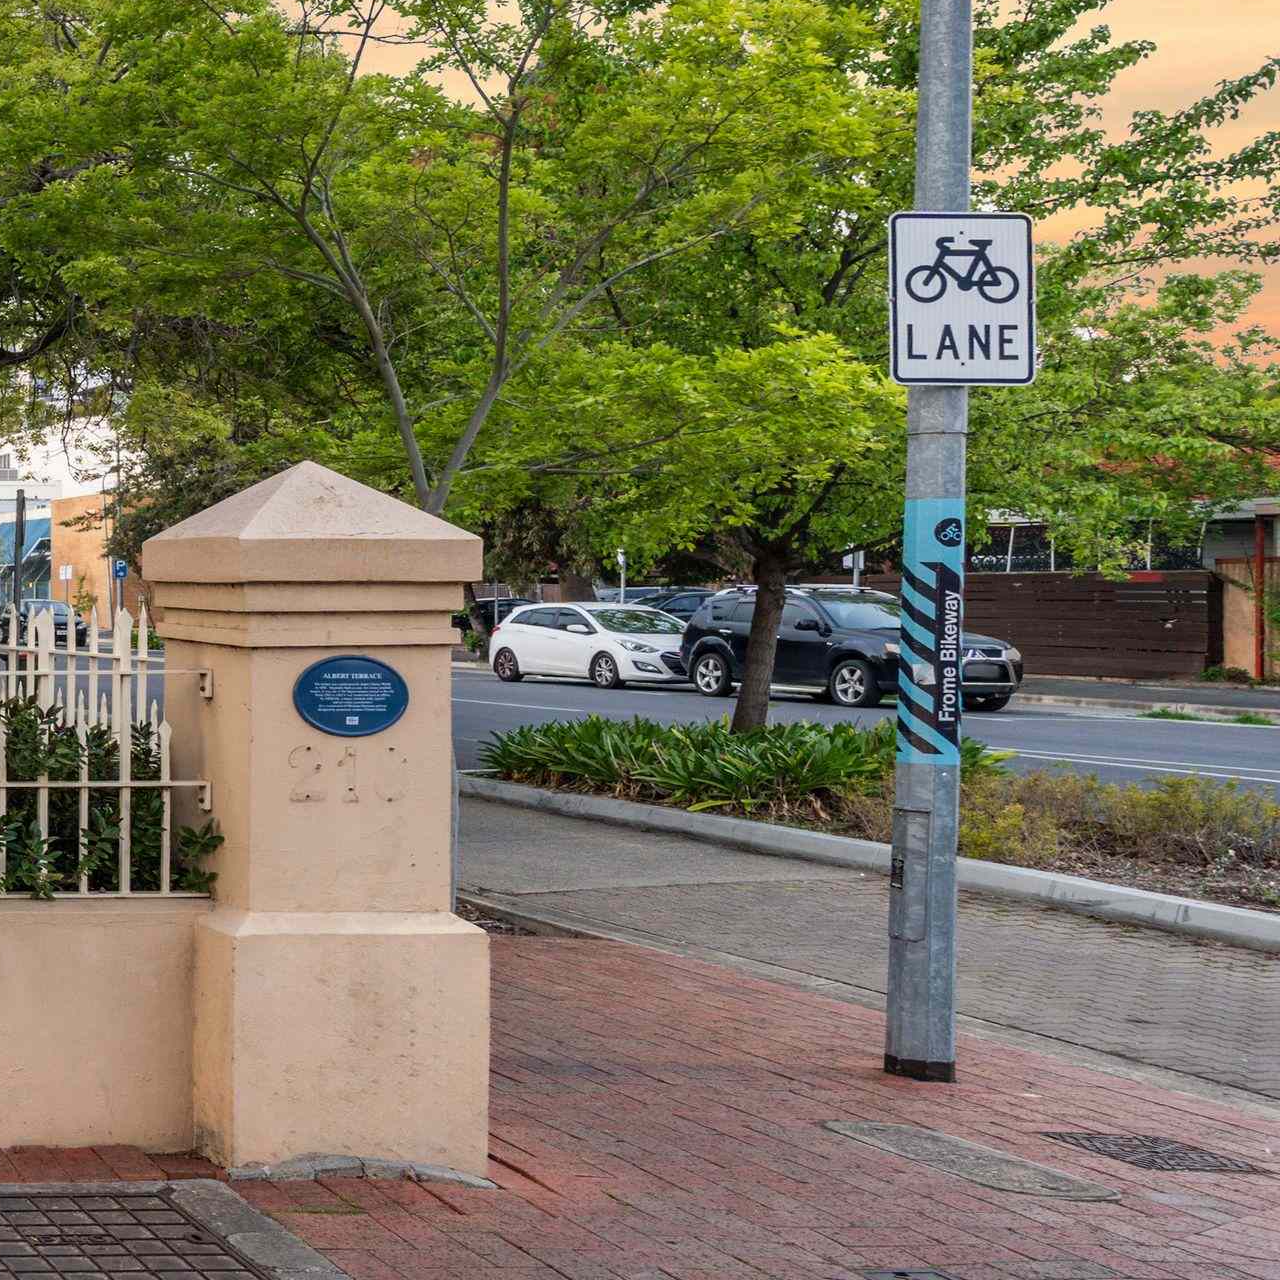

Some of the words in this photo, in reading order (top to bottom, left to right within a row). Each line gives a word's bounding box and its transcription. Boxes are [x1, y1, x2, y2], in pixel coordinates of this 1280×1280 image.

[906, 323, 1020, 361] LANE
[116, 560, 126, 571] P
[940, 589, 962, 662] Bikeway
[938, 666, 957, 722] Frome
